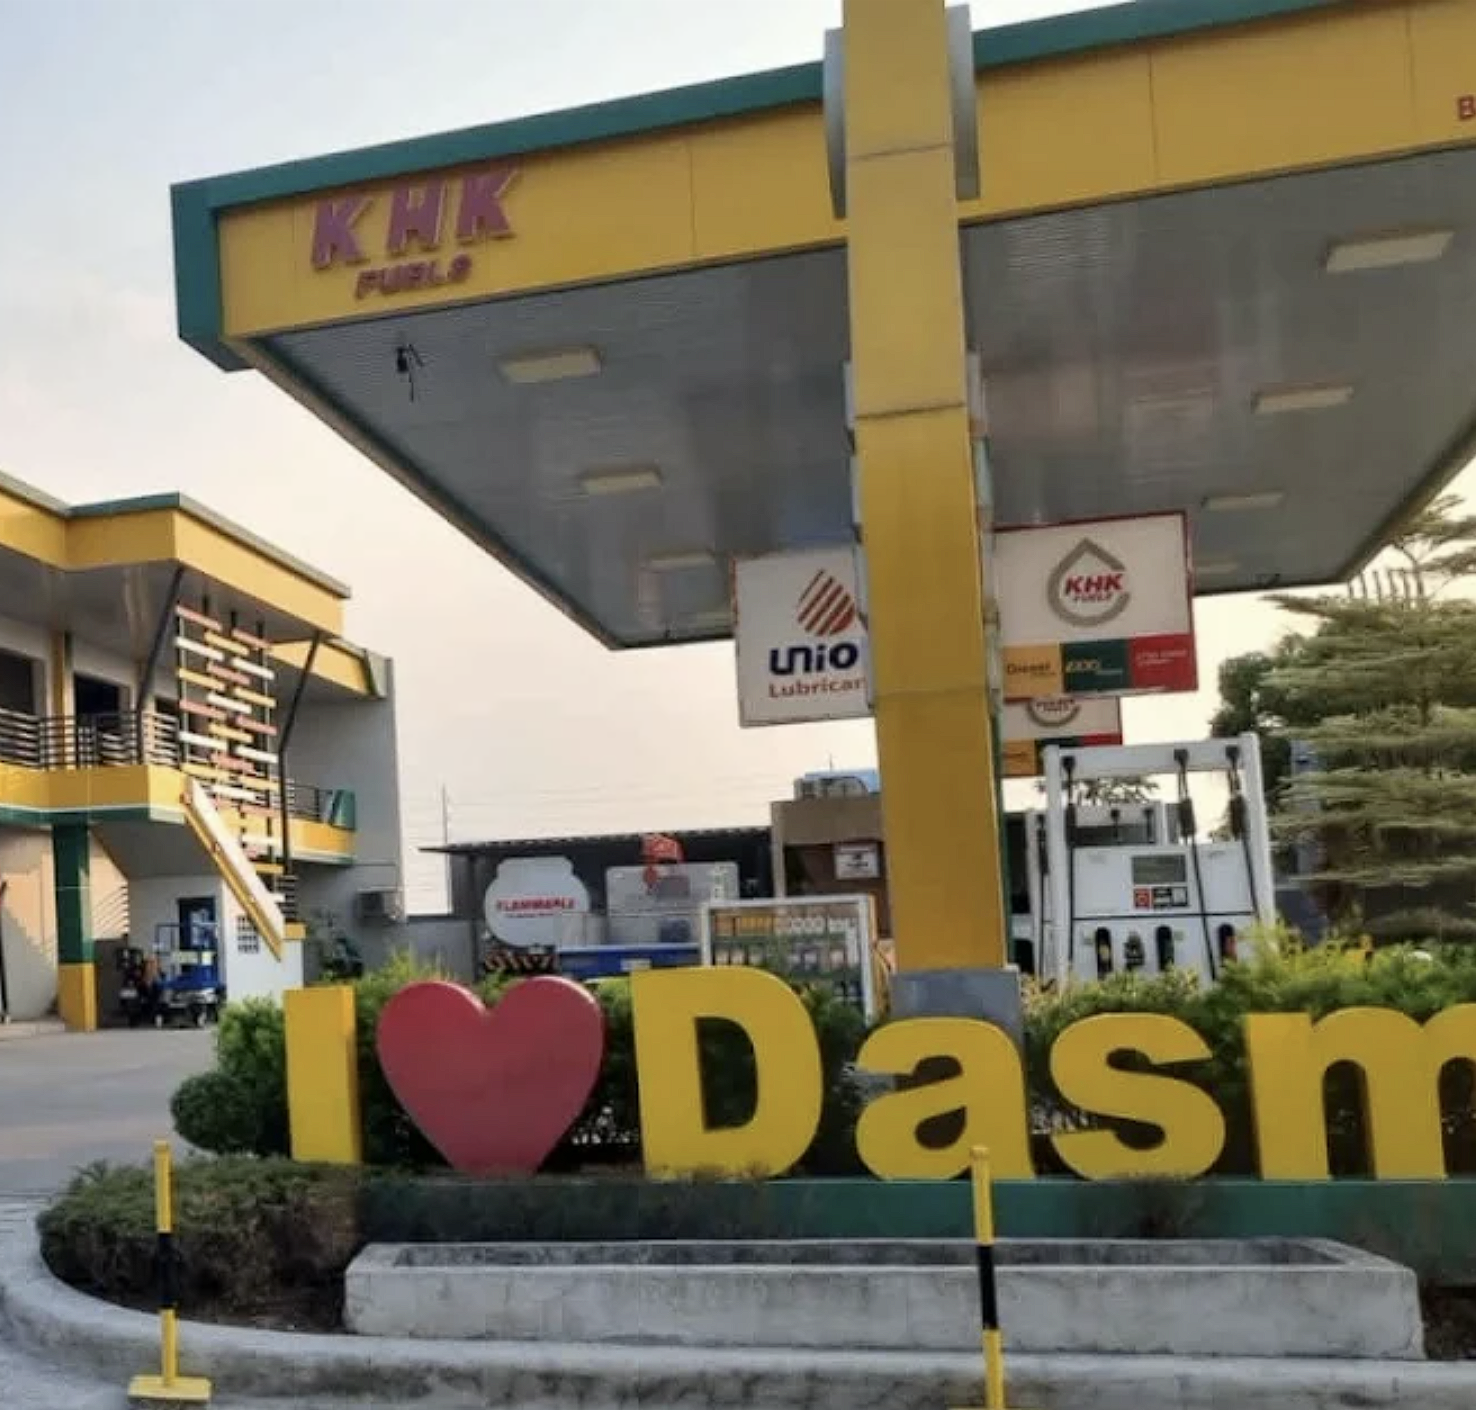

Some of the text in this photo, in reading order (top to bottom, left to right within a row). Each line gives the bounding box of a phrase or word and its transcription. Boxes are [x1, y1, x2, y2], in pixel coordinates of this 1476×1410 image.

[311, 165, 518, 268] KHK
[1065, 573, 1124, 595] KHK
[496, 896, 576, 911] FLAMMABLE
[284, 986, 360, 1165] I
